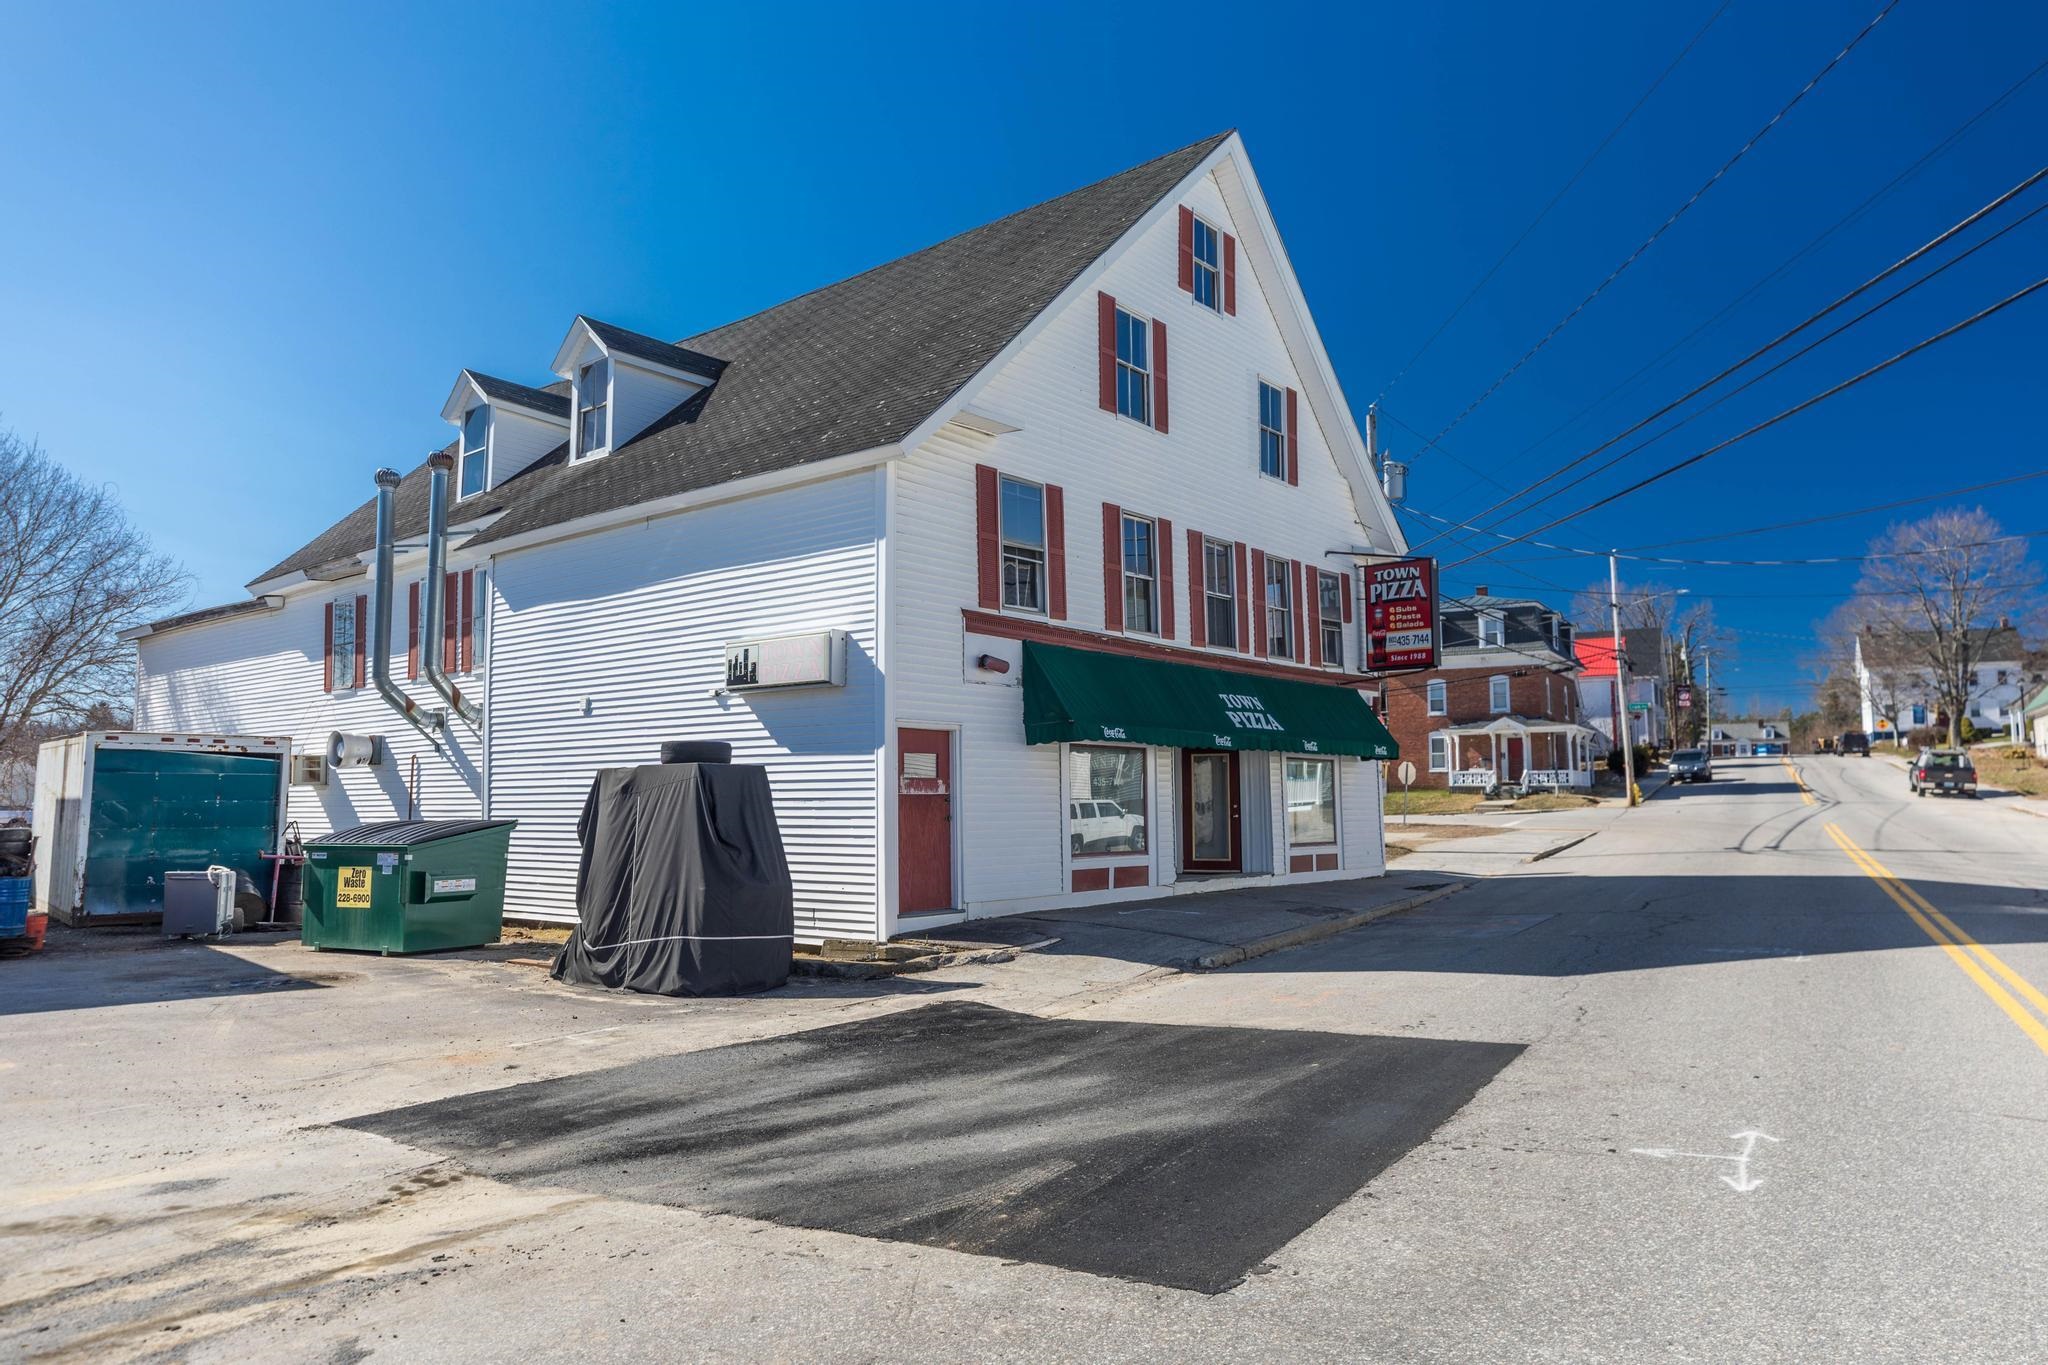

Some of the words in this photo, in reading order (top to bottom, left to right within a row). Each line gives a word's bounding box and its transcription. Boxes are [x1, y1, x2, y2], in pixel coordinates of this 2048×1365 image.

[1374, 567, 1420, 581] TOWN
[1370, 579, 1427, 603] PIZZA
[1396, 621, 1424, 629] Salads
[1219, 694, 1264, 711] TOWN
[1225, 711, 1285, 731] PIZZA
[351, 867, 366, 878] Zero
[344, 876, 365, 888] Waste
[338, 893, 369, 903] 228-6900
